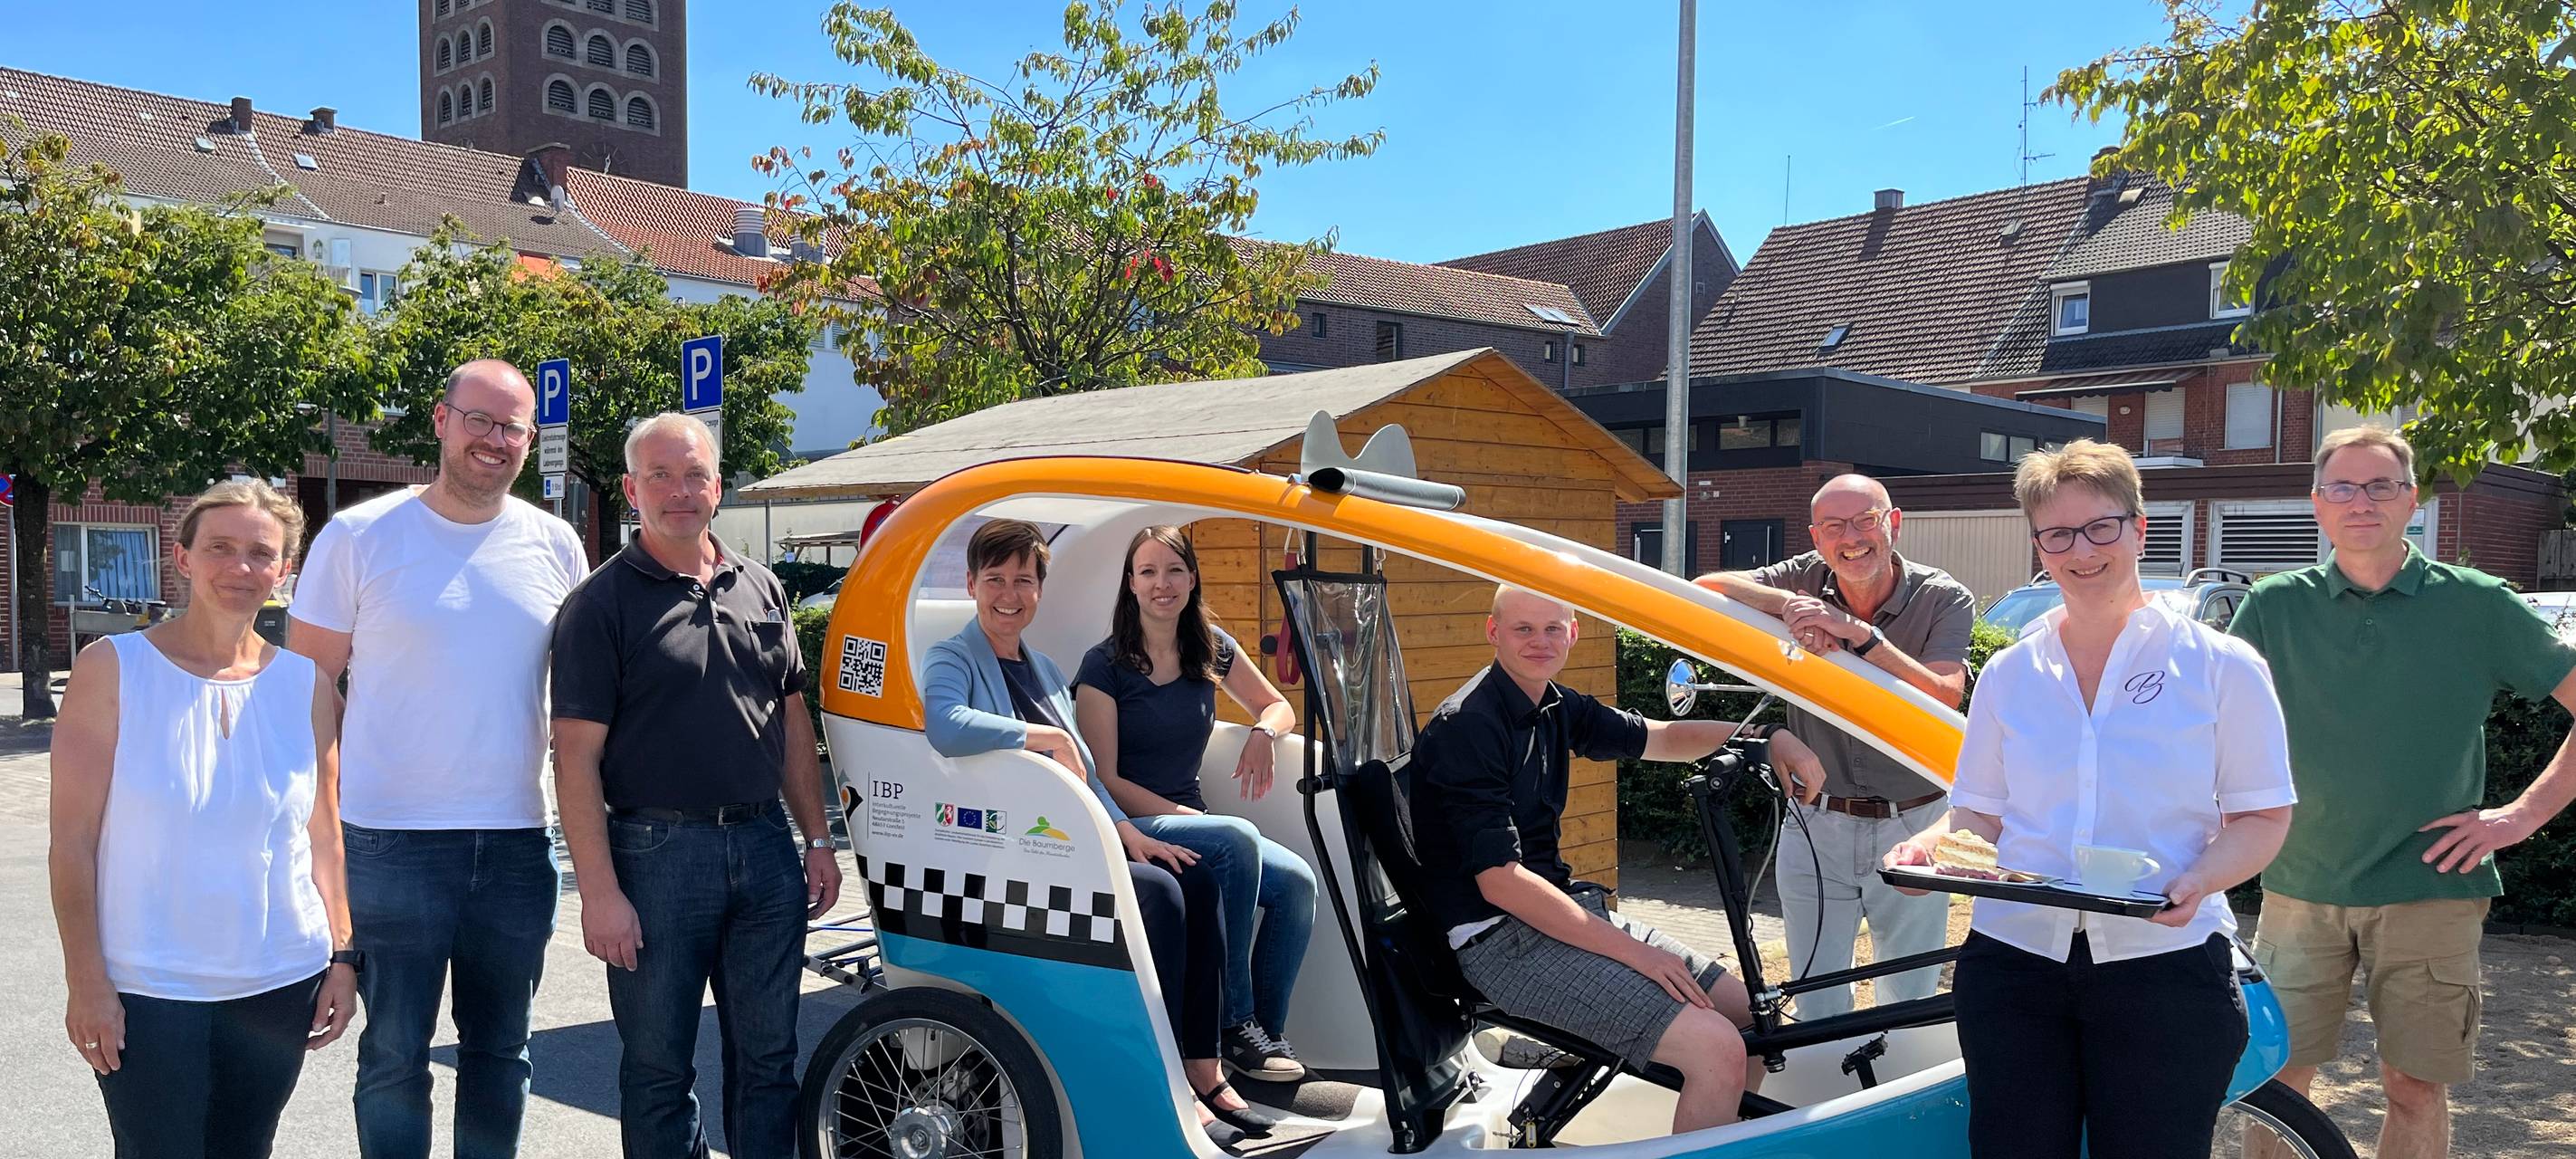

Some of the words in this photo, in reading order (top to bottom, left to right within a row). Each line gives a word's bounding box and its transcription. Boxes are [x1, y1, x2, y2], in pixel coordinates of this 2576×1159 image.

[691, 348, 712, 400] P
[544, 369, 561, 417] P
[873, 781, 903, 800] IBP
[1019, 838, 1031, 847] Die
[1032, 839, 1076, 853] Baumberge
